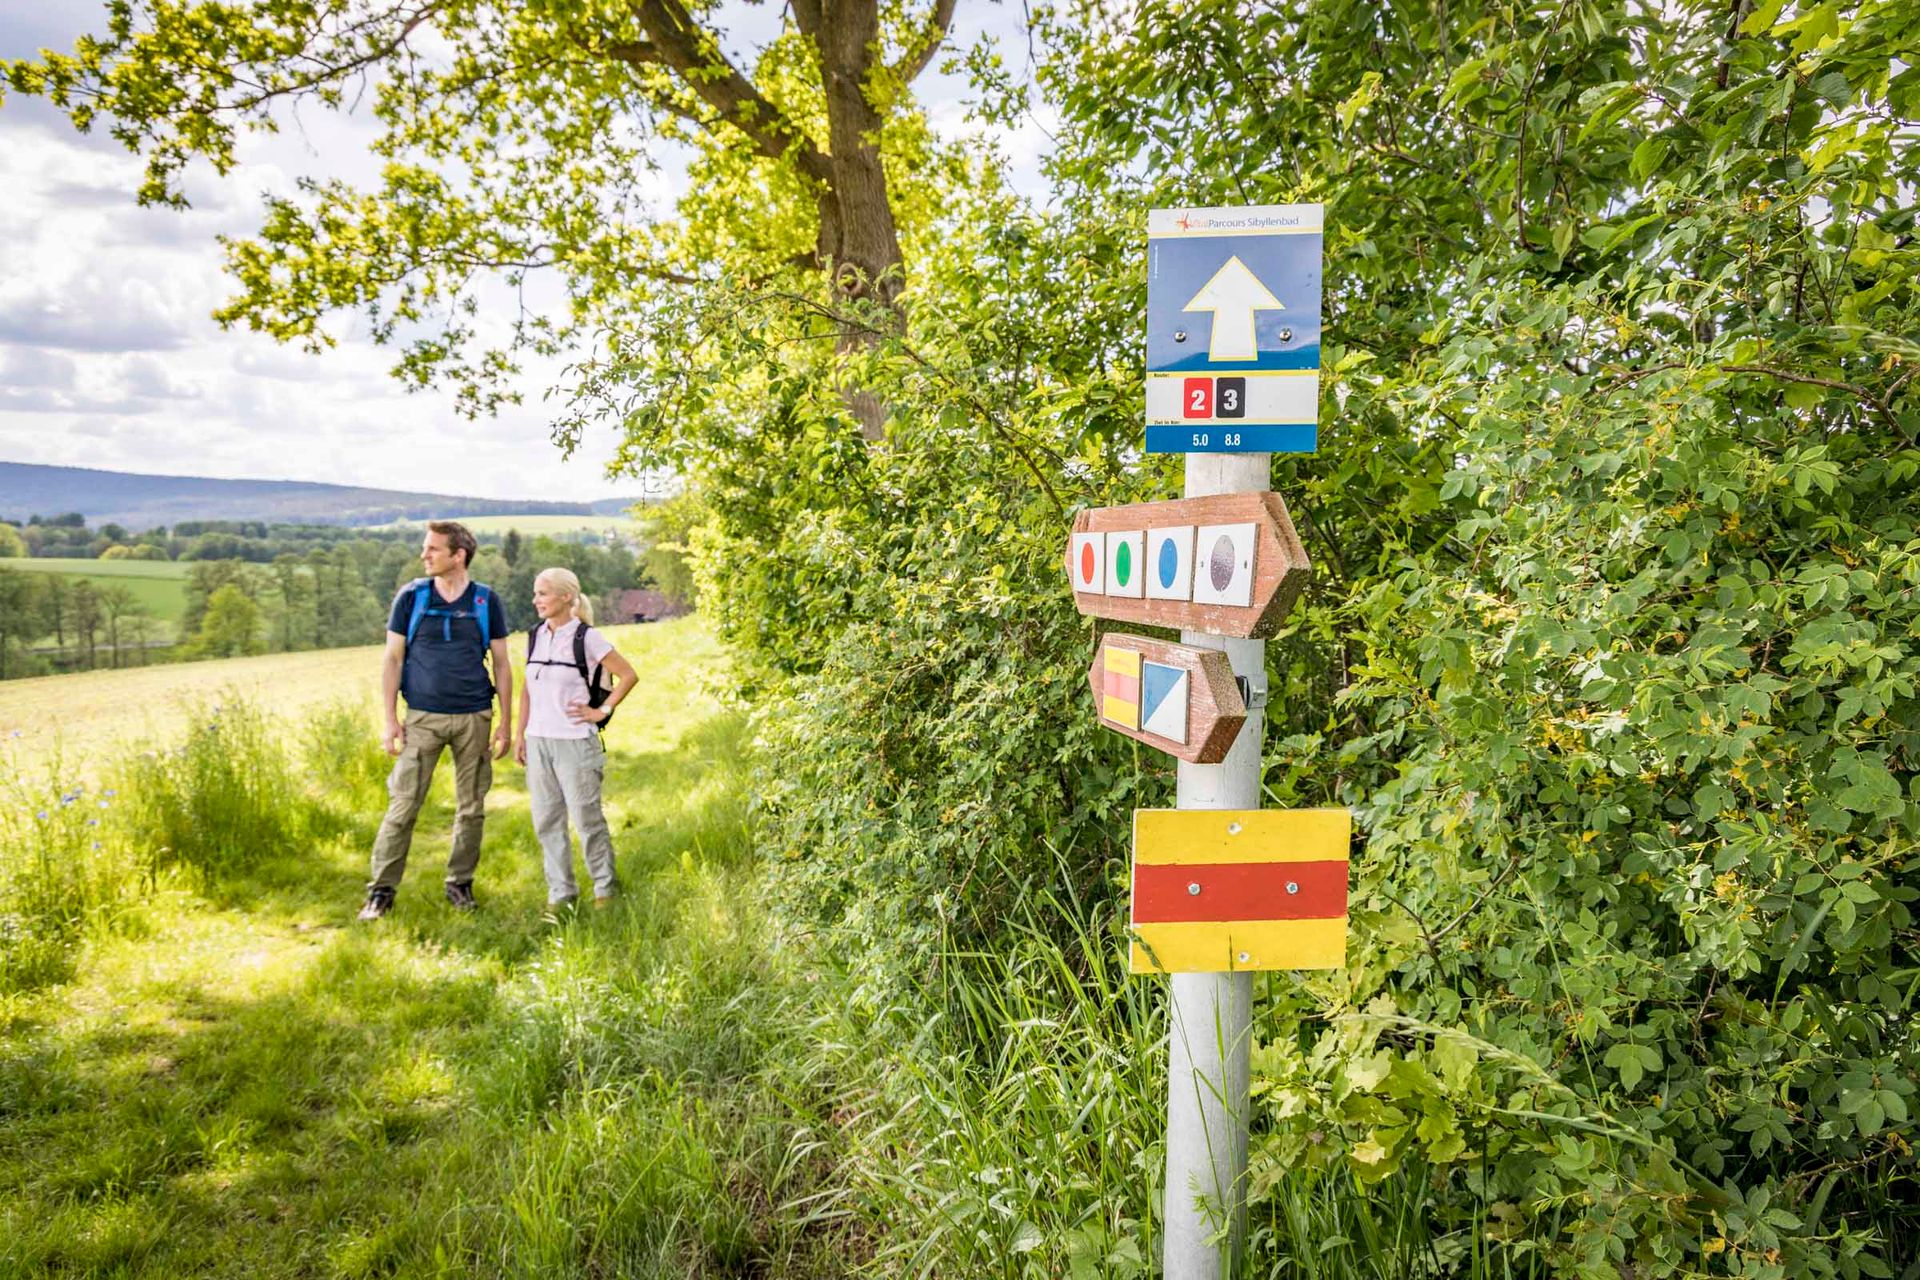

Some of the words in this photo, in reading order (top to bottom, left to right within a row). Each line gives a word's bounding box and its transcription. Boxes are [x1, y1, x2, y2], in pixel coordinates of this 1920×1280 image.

[1247, 217, 1299, 229] Sibyllenbad
[1191, 390, 1205, 411] 2
[1224, 389, 1238, 411] 3
[1193, 434, 1208, 446] 5.0
[1225, 434, 1240, 446] 8.8
